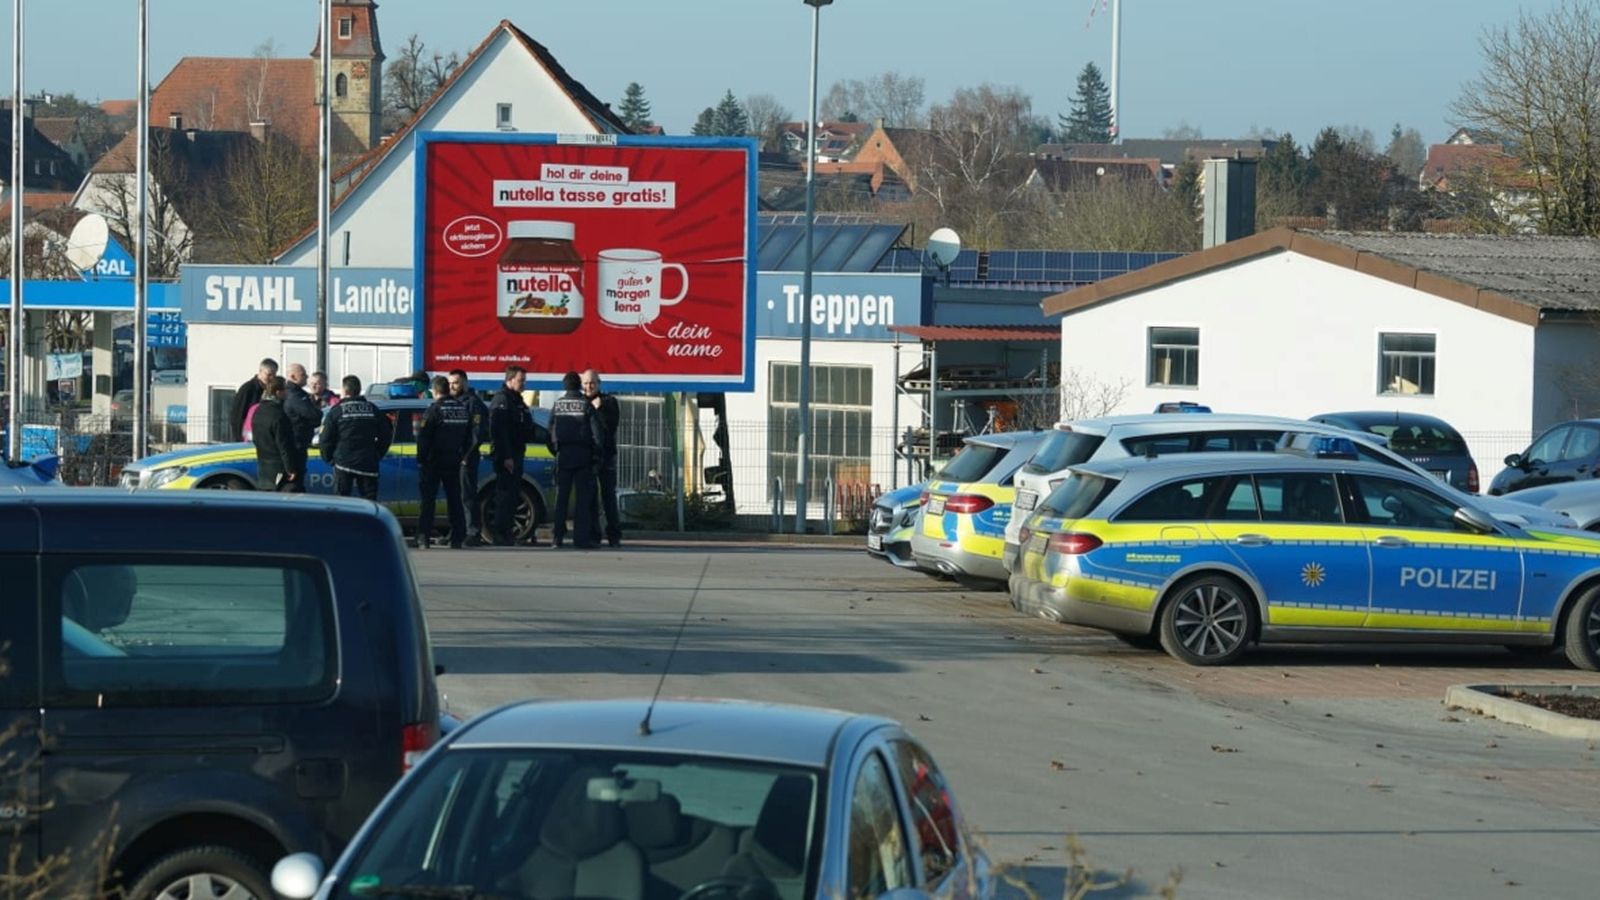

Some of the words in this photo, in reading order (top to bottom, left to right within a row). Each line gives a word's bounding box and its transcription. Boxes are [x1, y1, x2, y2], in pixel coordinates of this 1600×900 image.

[546, 168, 564, 178] hol
[569, 169, 585, 180] dir
[589, 170, 623, 181] deine
[499, 186, 554, 201] nutella
[559, 188, 606, 202] tasse
[612, 188, 667, 206] gratis!
[91, 259, 131, 275] RAL
[507, 275, 571, 292] nutella
[205, 275, 302, 311] STAHL
[606, 289, 650, 301] morgen
[615, 301, 641, 312] lena
[667, 321, 712, 339] dein
[667, 344, 723, 357] name
[342, 404, 373, 413] POLIZEI
[1400, 567, 1496, 590] POLIZEI
